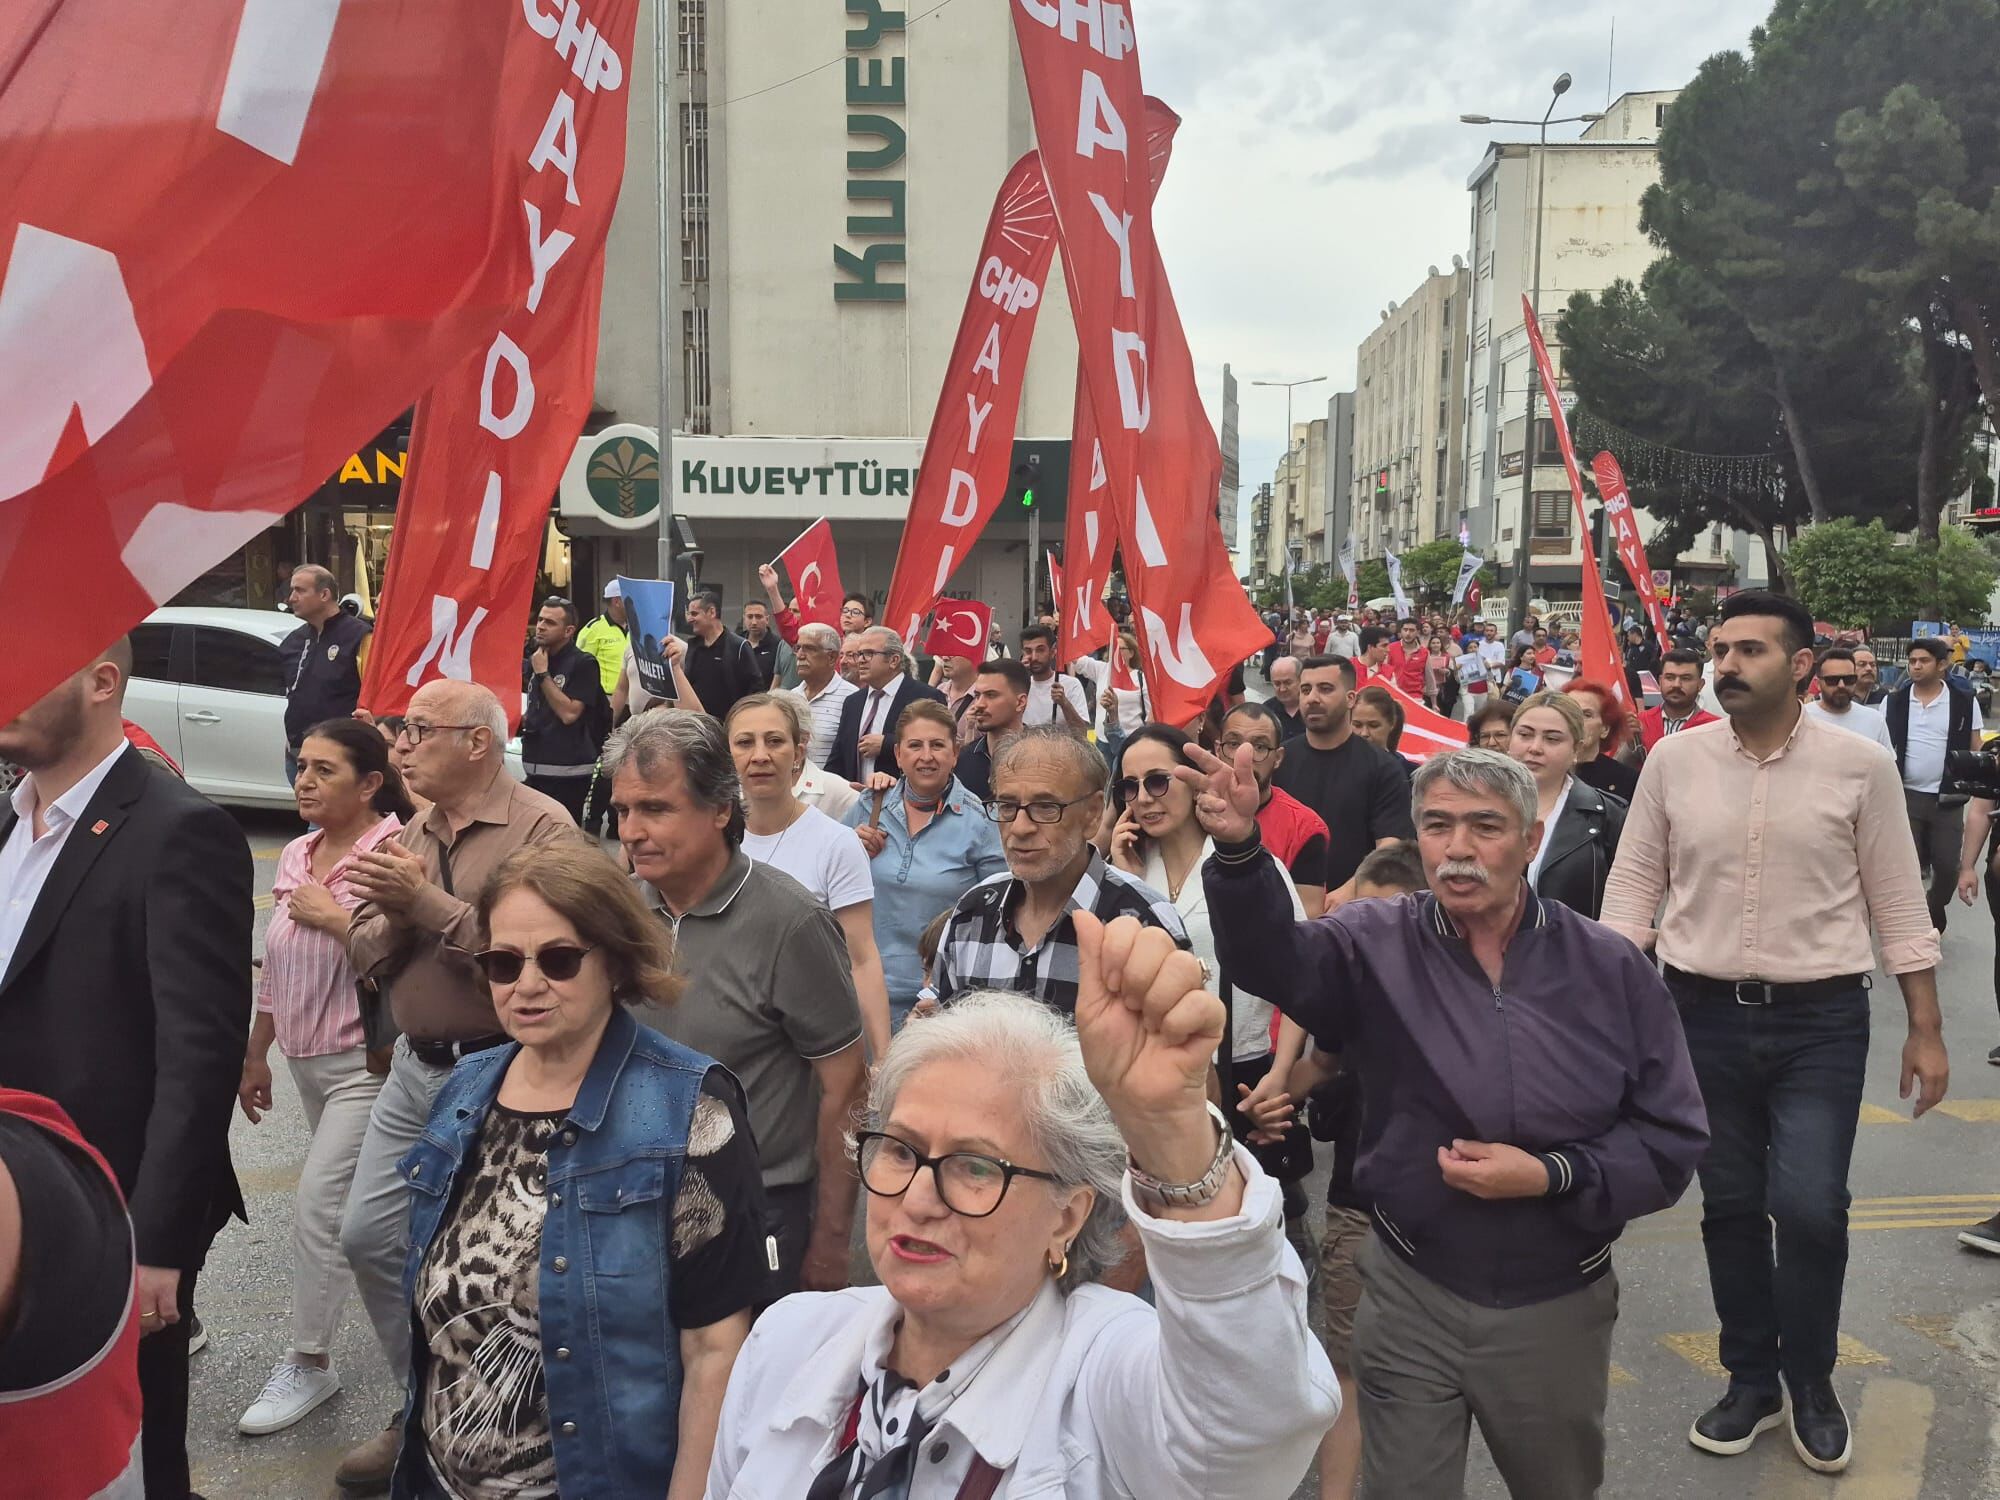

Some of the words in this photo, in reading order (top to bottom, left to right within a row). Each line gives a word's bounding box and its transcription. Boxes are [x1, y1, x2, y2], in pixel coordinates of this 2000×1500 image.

[522, 0, 623, 94] CHP
[834, 0, 906, 302] KUVEY
[979, 255, 1039, 315] CHP
[406, 88, 580, 688] AYDIN
[682, 459, 921, 496] KUVEYTTÜR
